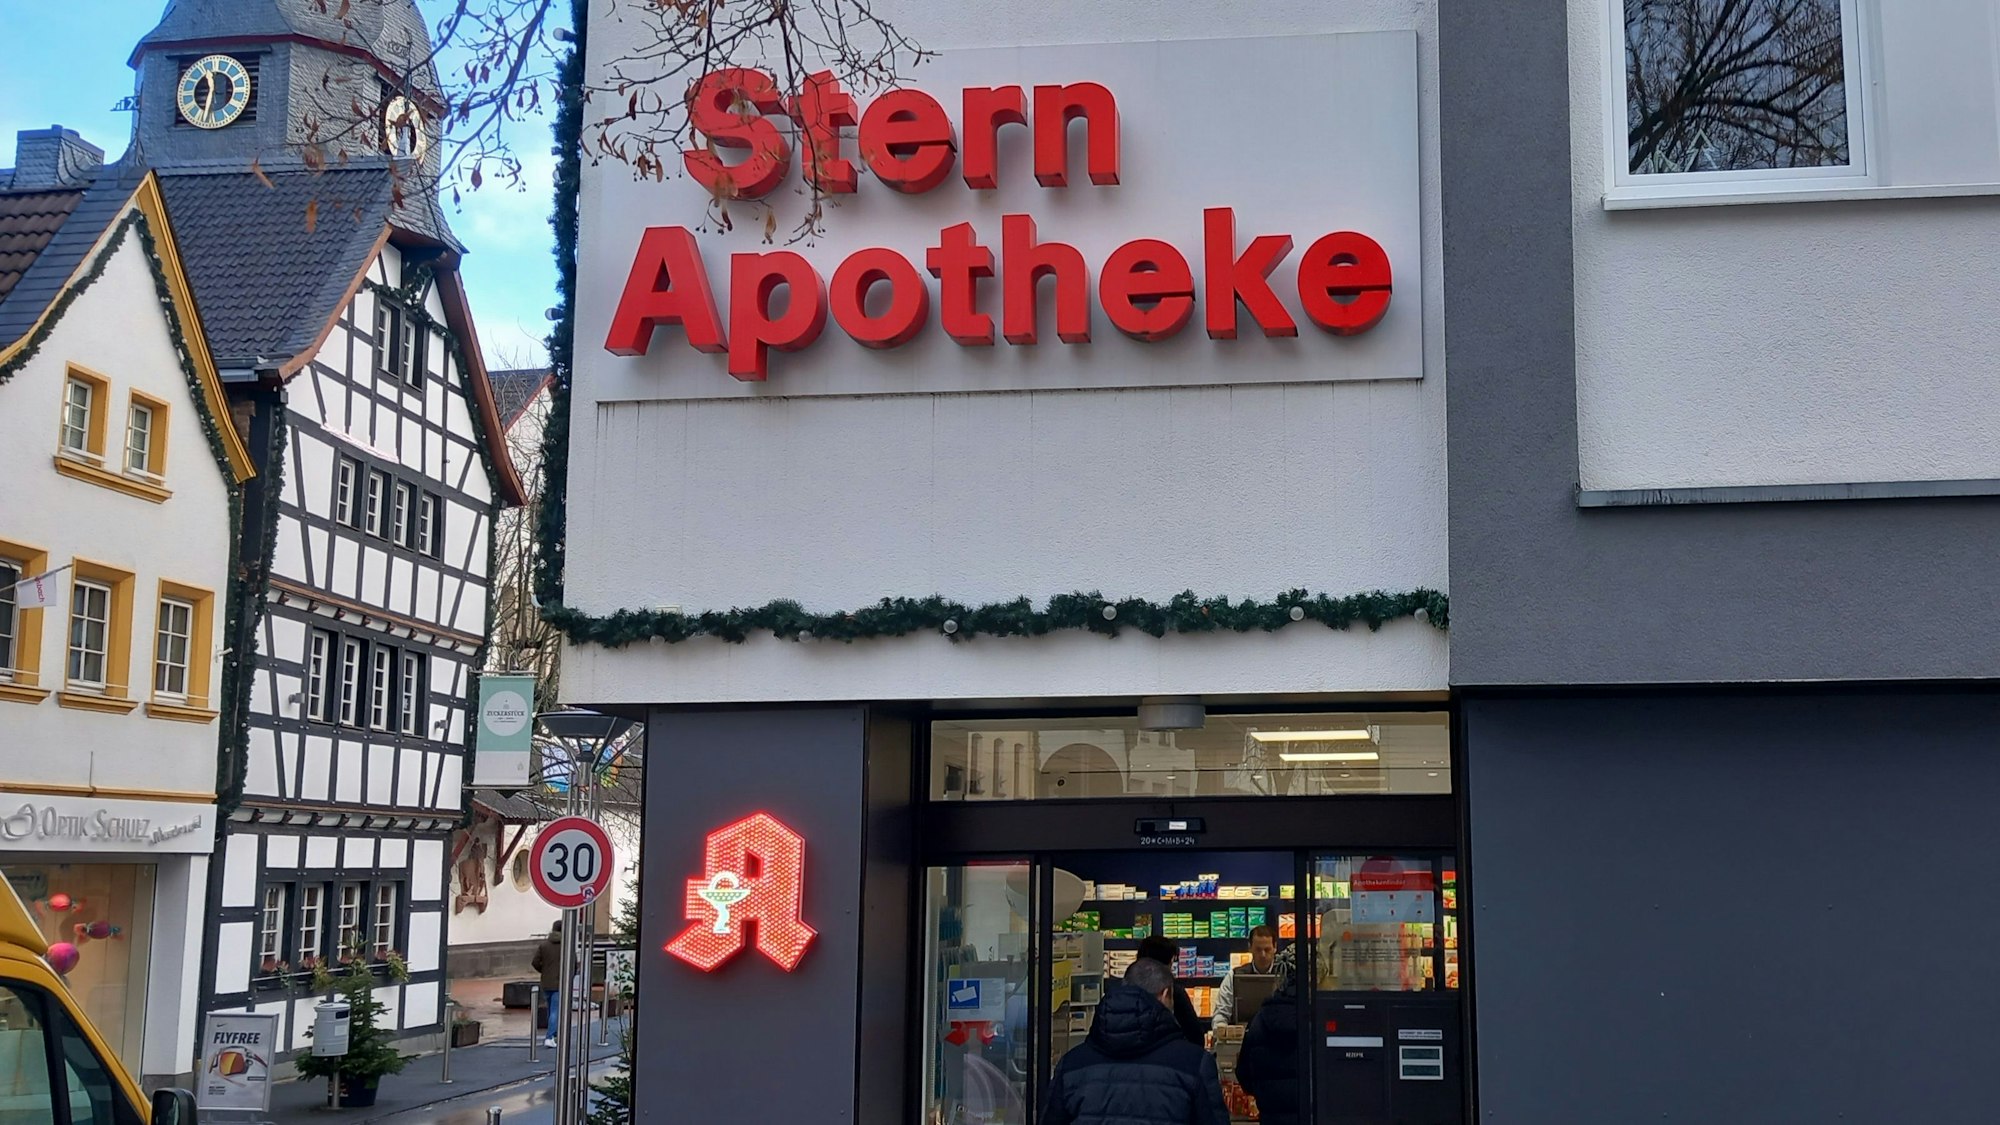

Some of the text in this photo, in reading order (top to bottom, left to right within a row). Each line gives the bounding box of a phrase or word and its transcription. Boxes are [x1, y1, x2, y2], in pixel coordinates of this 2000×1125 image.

[684, 68, 1120, 199] Stern
[605, 207, 1393, 382] Apotheke
[547, 842, 595, 883] 30
[213, 1032, 261, 1044] FLYFREE
